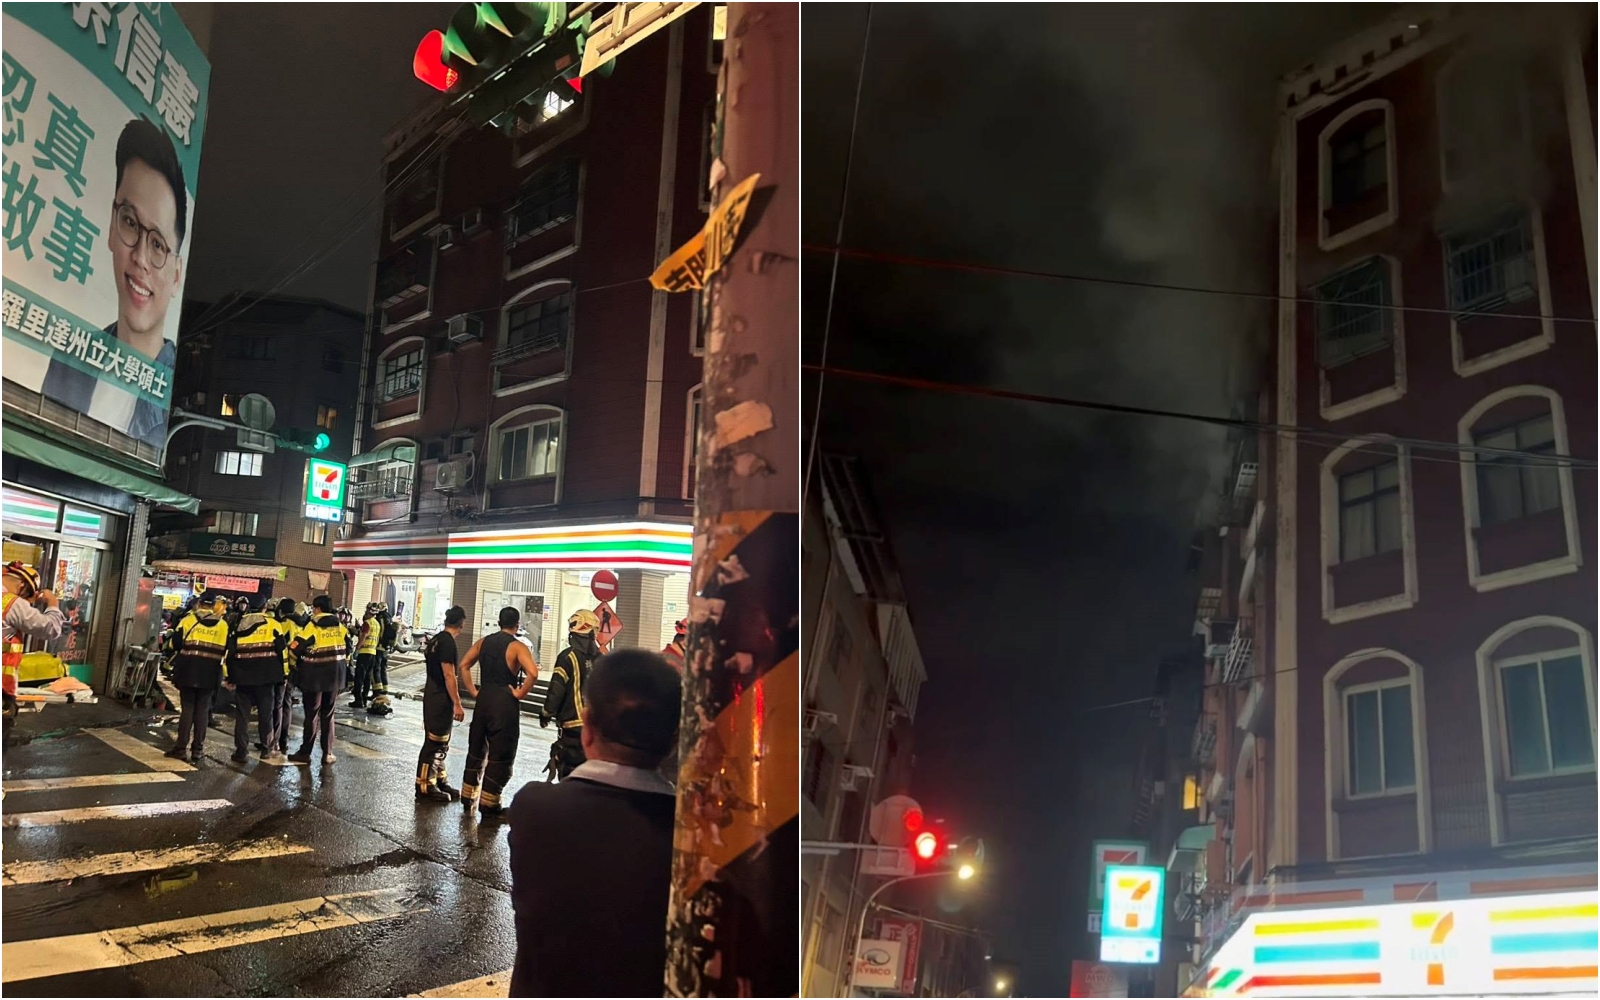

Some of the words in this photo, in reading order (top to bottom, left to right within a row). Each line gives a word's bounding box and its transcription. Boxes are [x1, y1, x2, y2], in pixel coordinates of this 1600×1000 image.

[2, 287, 168, 399] 羅里達州立大學碩士
[193, 627, 219, 637] POLICE
[321, 630, 343, 639] POLICE
